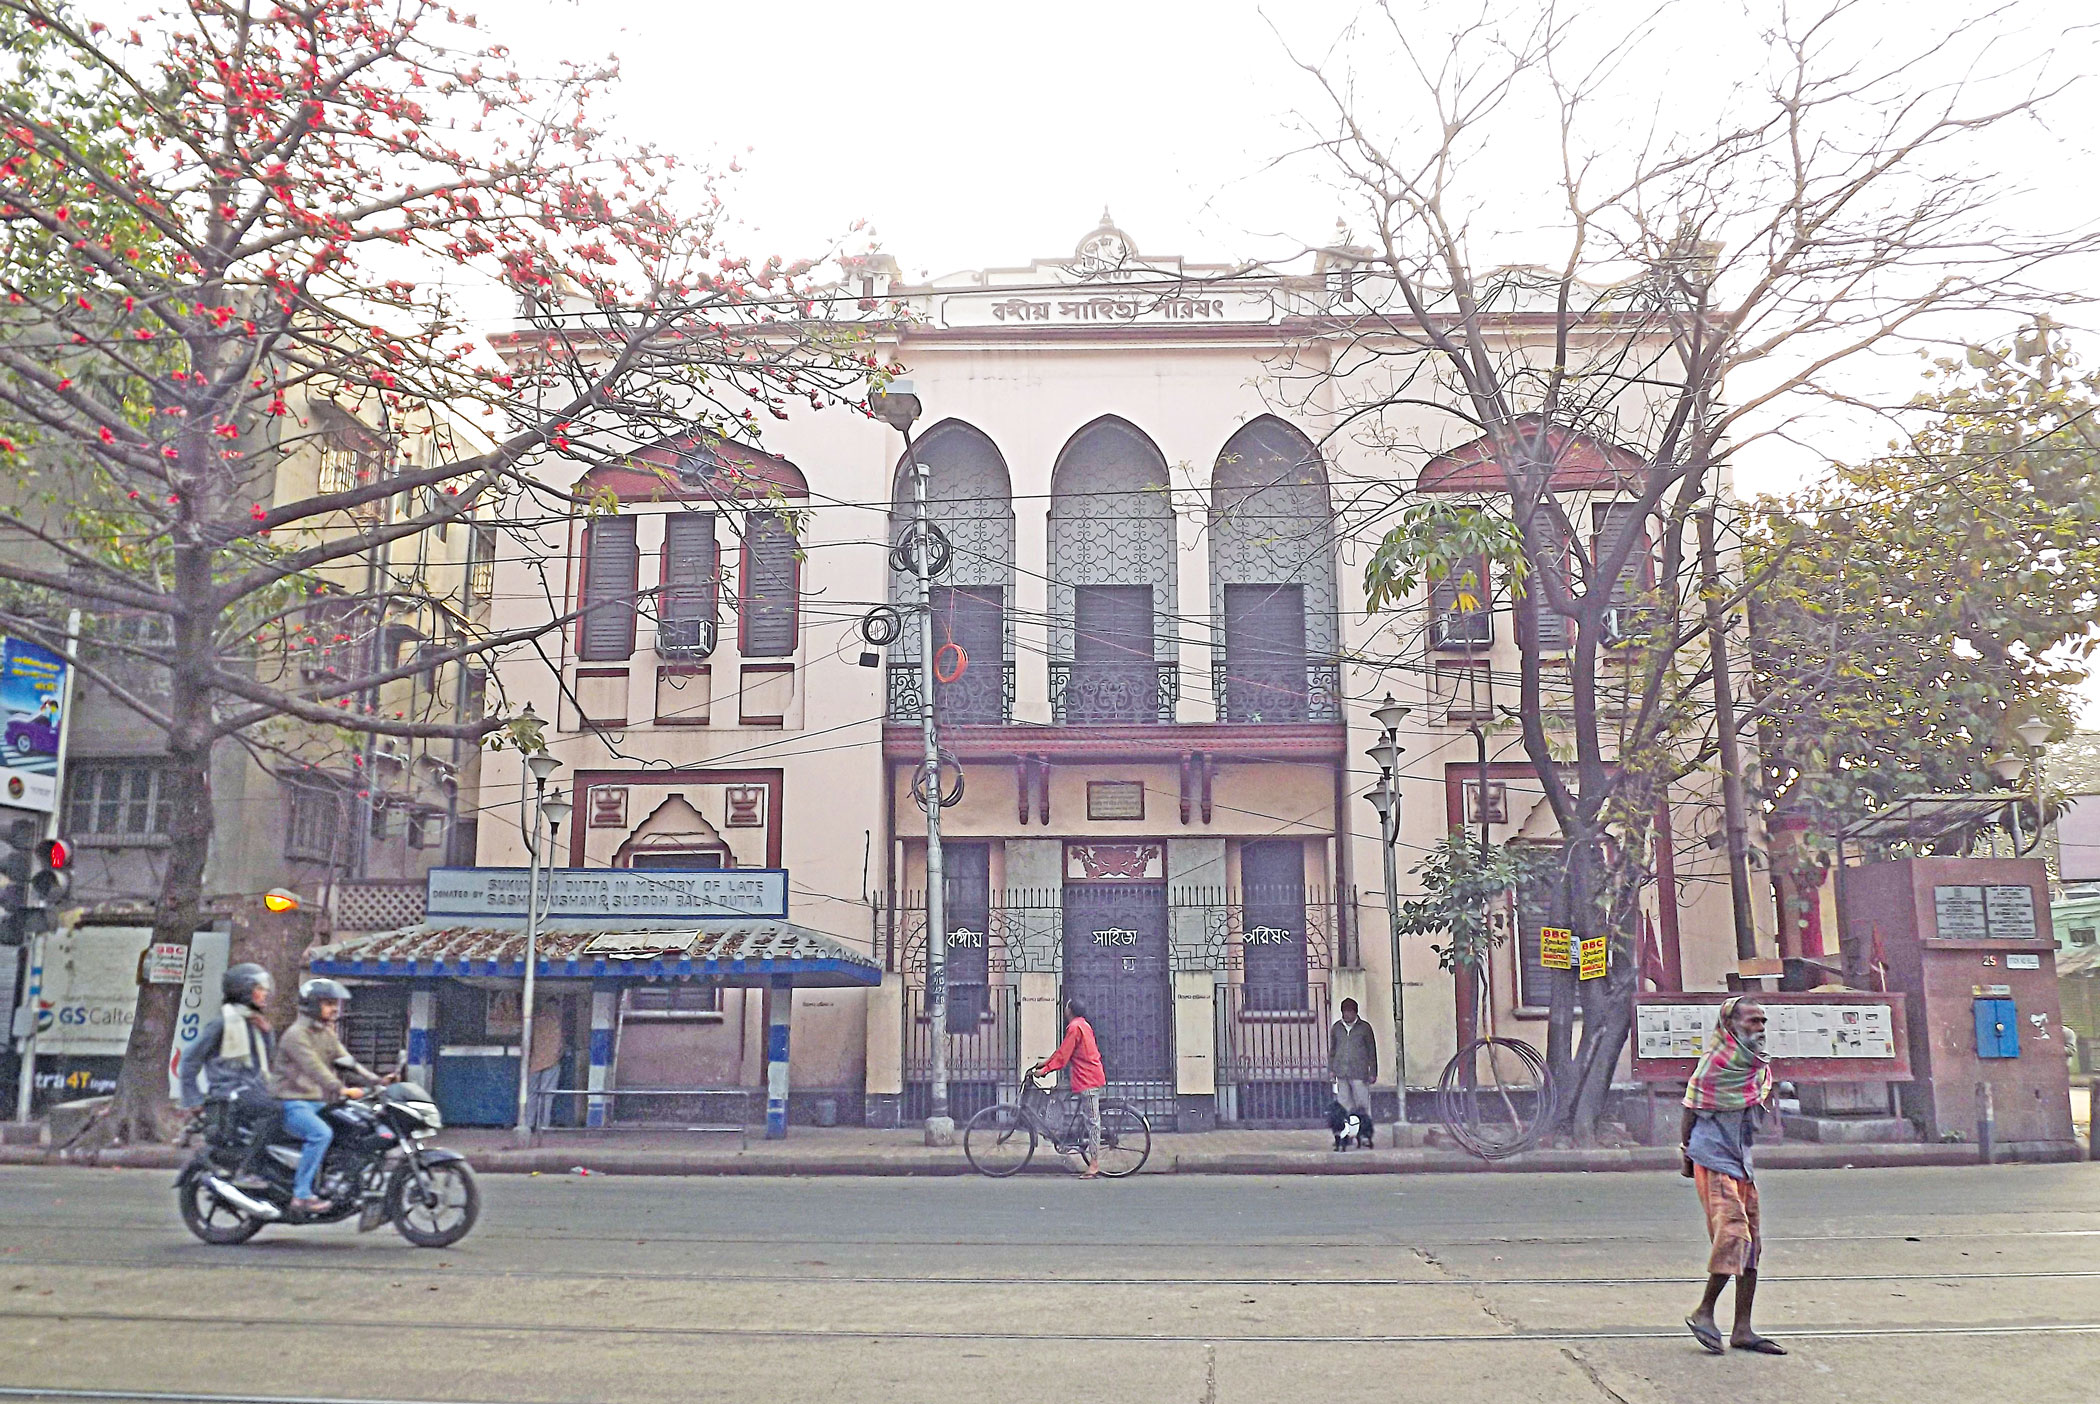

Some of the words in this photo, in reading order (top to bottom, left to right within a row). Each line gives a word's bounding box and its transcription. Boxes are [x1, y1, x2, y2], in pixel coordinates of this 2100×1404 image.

[991, 298, 1051, 321] বঙ্গীয়
[1058, 297, 1139, 320] সাহিত্য
[1152, 297, 1224, 319] পরিষৎ
[433, 890, 468, 898] DONATED
[473, 890, 483, 898] BY
[566, 880, 609, 892] DUTTA
[616, 881, 628, 892] IN
[636, 880, 695, 892] MEMORY
[704, 881, 720, 892] OF
[729, 881, 764, 892] LATE
[487, 894, 597, 907] SASHIHUSHAN
[677, 895, 711, 907] BALA
[720, 895, 763, 907] DUTTA
[947, 927, 984, 948] বঙ্গীয়
[1092, 927, 1138, 947] সাহিত্য
[1242, 925, 1293, 945] পরিষৎ
[1543, 929, 1568, 939] BBC
[1582, 940, 1603, 950] BBC
[185, 952, 206, 1009] Caltex
[59, 1006, 86, 1025] GS
[90, 1008, 134, 1025] Calte
[181, 1012, 200, 1041] GS
